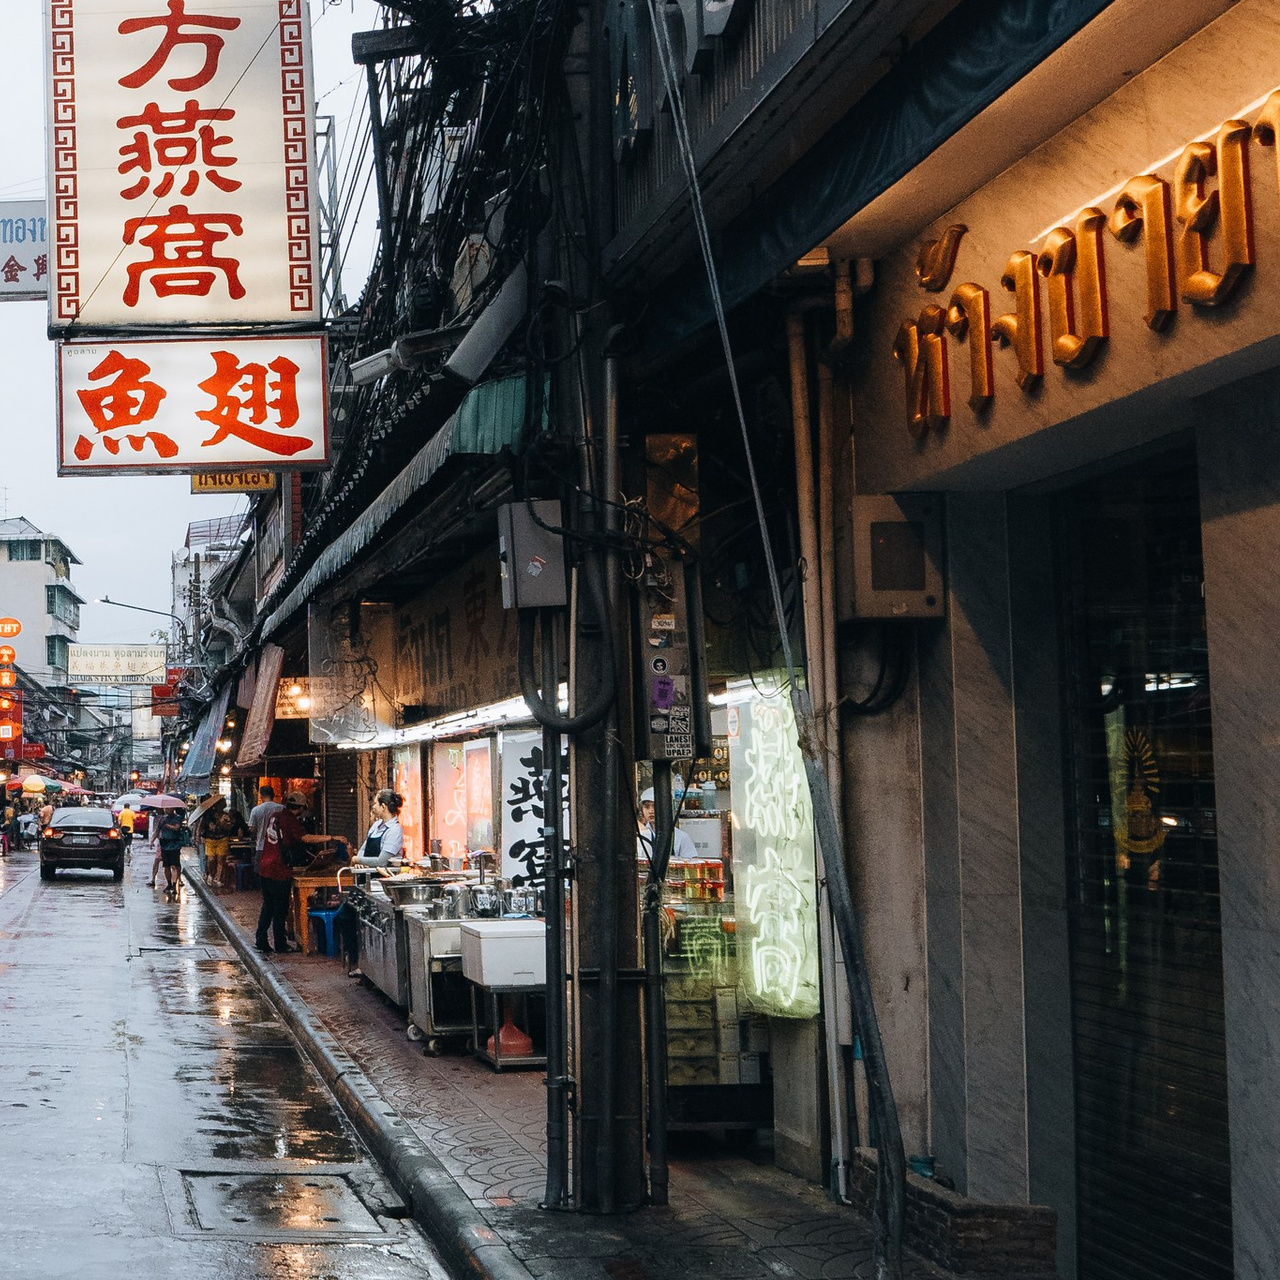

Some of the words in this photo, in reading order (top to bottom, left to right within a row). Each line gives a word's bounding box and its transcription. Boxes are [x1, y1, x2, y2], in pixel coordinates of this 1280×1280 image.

[892, 89, 1280, 438] ห้างขาย
[73, 349, 314, 461] 魚翅
